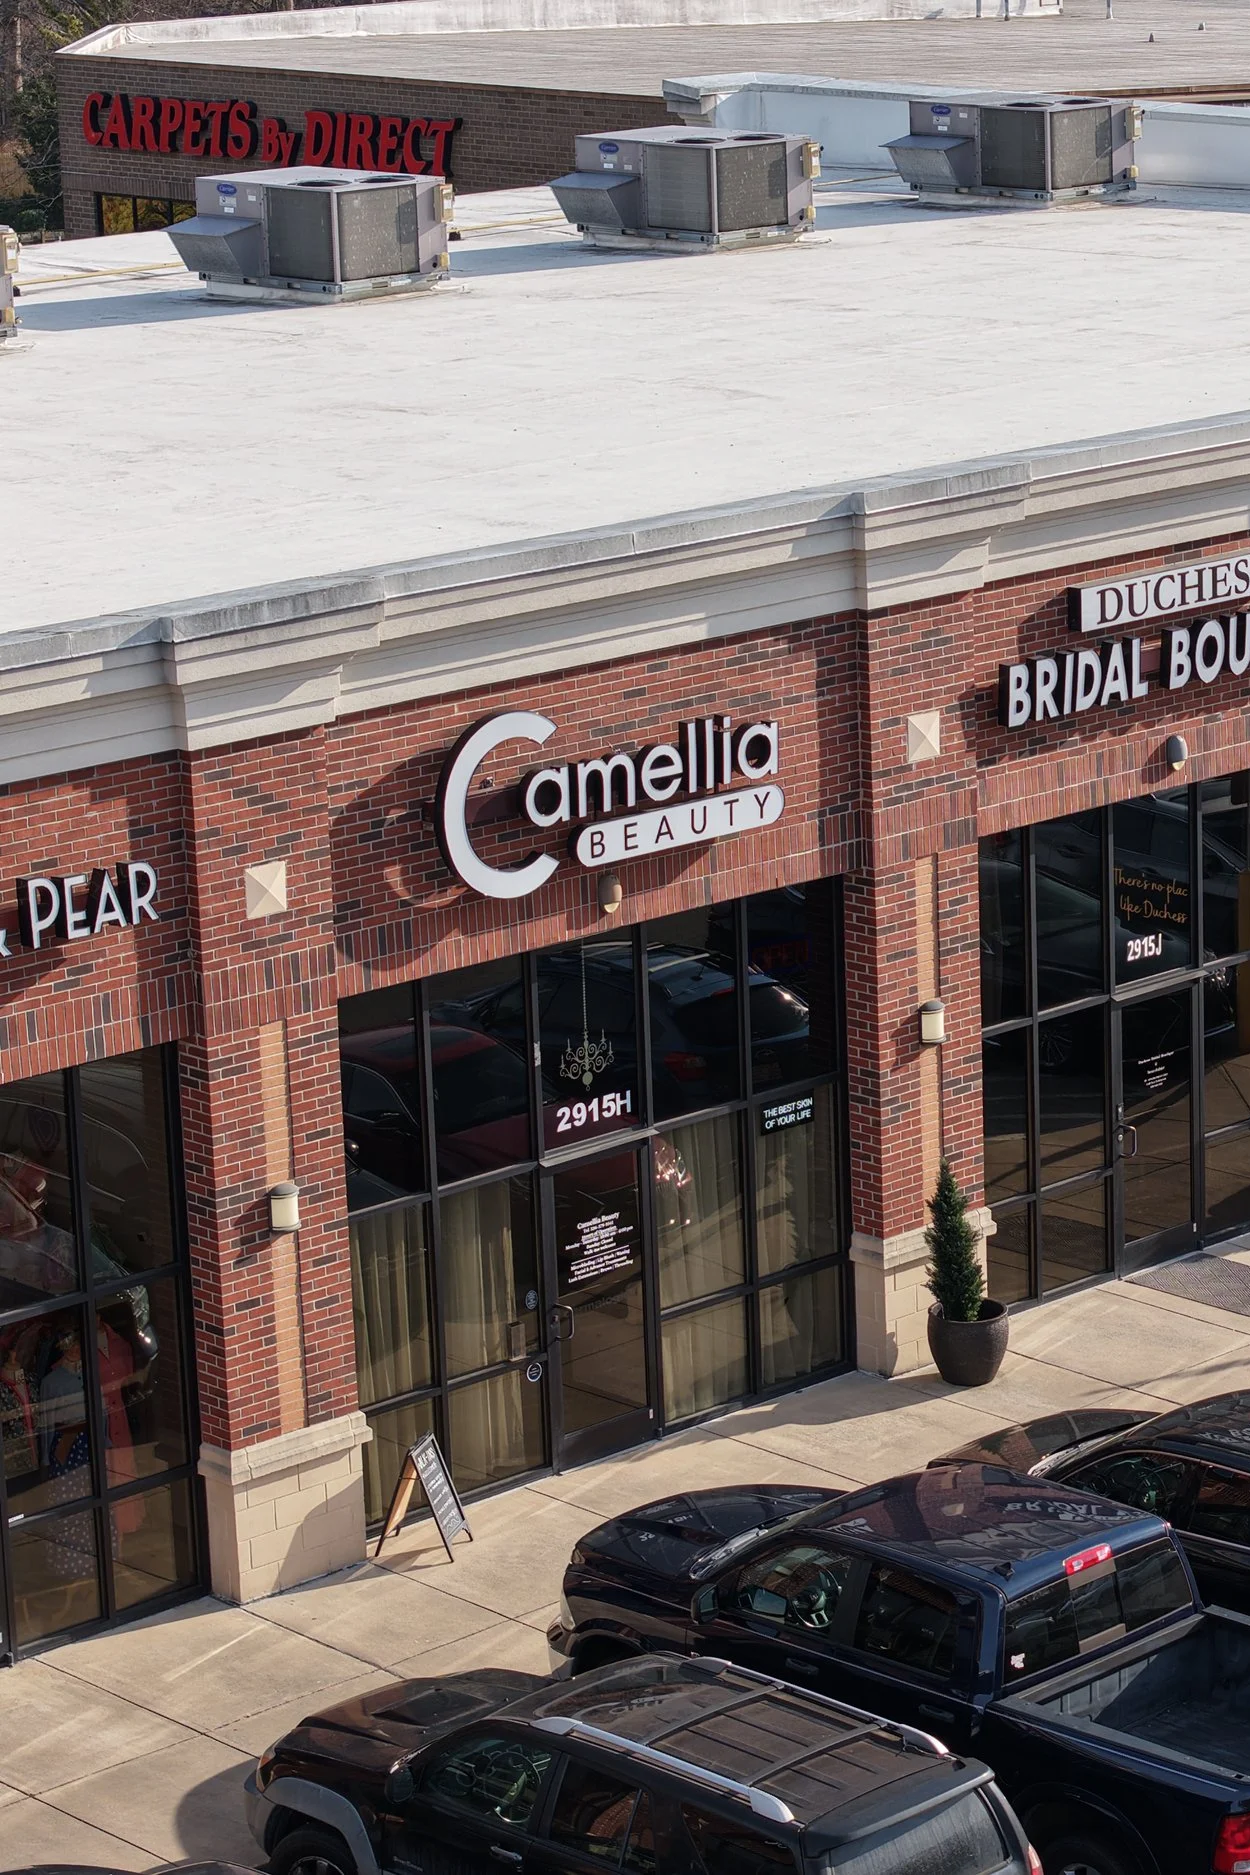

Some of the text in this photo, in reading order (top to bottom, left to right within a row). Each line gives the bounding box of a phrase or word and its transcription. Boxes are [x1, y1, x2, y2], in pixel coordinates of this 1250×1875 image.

[82, 91, 254, 160] CARPETS
[304, 111, 458, 177] DIRECT
[1006, 635, 1150, 728] BRIDAL
[442, 709, 780, 899] Camellia
[590, 790, 771, 859] BEAUTY
[27, 862, 160, 949] PEAR
[1112, 867, 1189, 904] There's no plac
[1143, 899, 1189, 924] Duchess
[1126, 932, 1162, 962] 2915J
[556, 1089, 632, 1133] 2915H
[763, 1097, 813, 1118] THE BEST SKIN
[765, 1109, 812, 1130] OF YOUR LIFE
